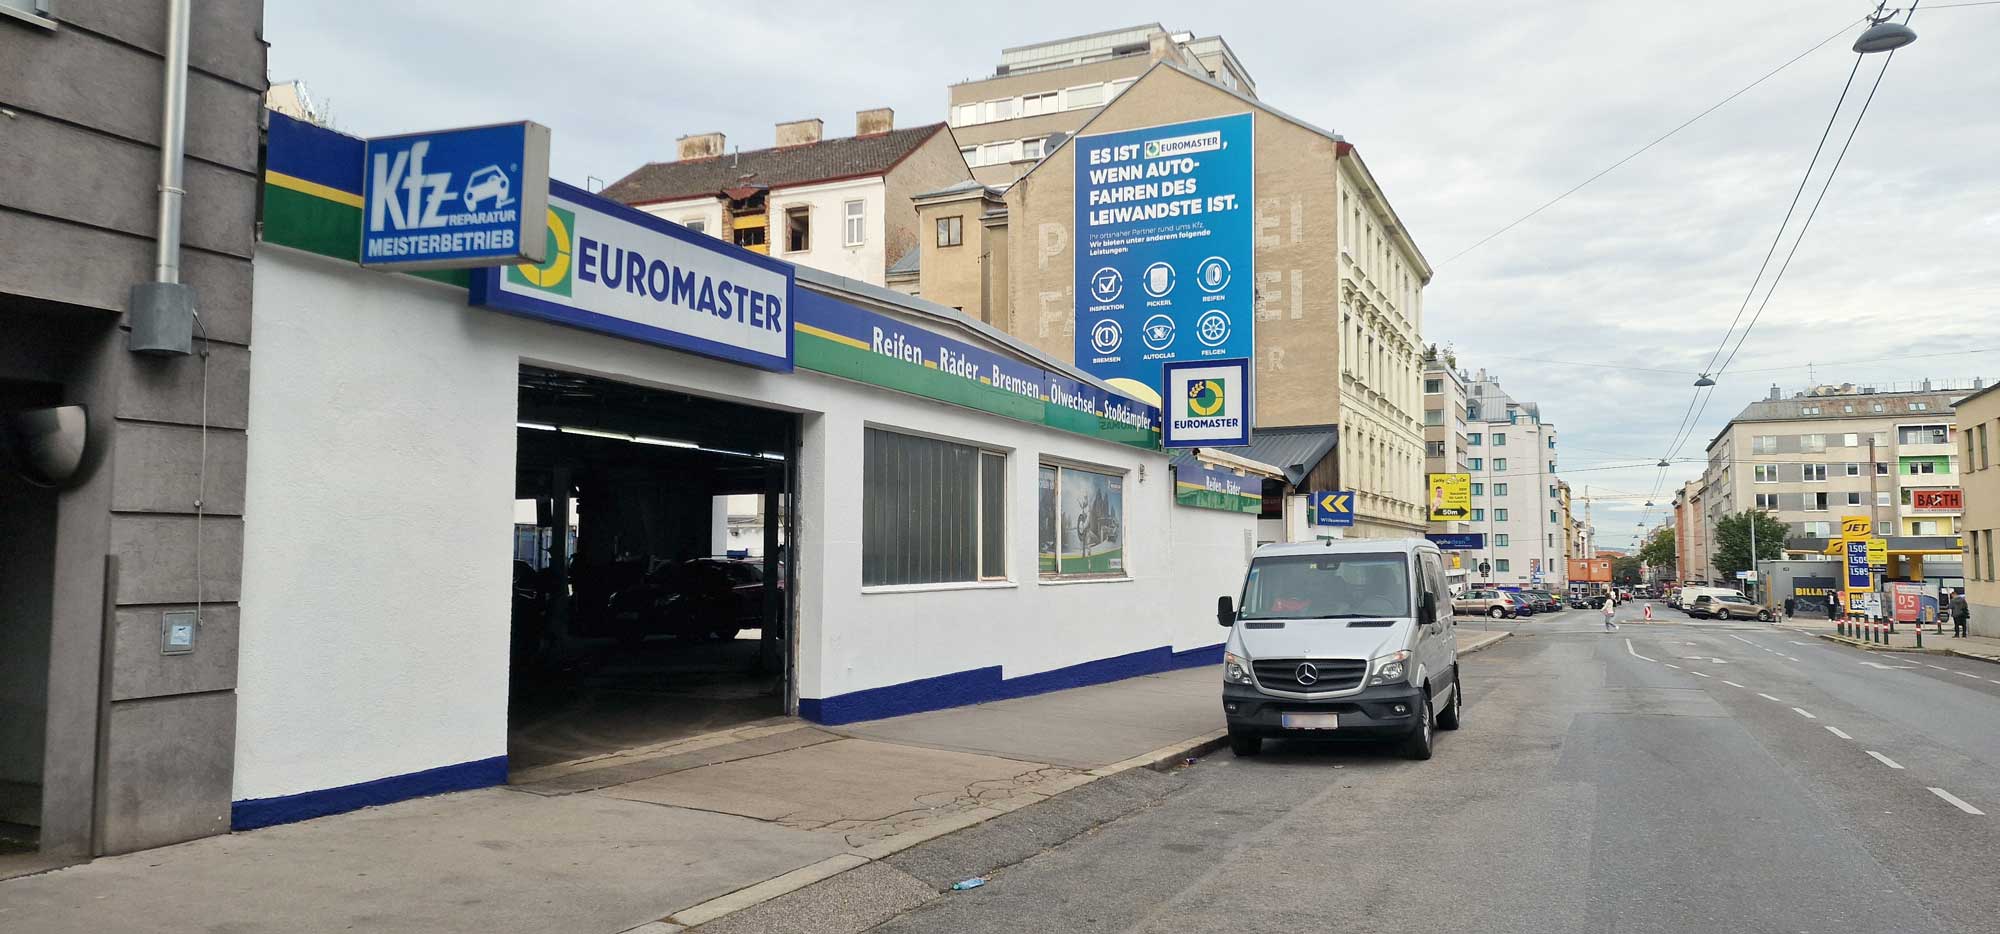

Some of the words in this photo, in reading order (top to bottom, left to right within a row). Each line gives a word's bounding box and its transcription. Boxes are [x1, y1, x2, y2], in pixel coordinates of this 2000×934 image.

[1090, 148, 1111, 165] ES
[1114, 144, 1140, 162] IST
[1090, 165, 1143, 185] WENN
[1146, 157, 1200, 178] AUTO-
[371, 140, 459, 232] Kfz
[1090, 183, 1158, 206] FAHREN
[1162, 178, 1197, 197] DES
[449, 210, 516, 226] REPARATUR
[1090, 198, 1203, 226] LEIWANDSTE
[1207, 194, 1239, 213] IST.
[1090, 233, 1099, 241] Ihr
[1099, 229, 1131, 240] ortsnaher
[1132, 227, 1156, 237] Partner
[1158, 225, 1174, 234] rund
[1176, 223, 1191, 232] ums
[1090, 240, 1102, 249] Wir
[1103, 238, 1125, 247] bieten
[1126, 236, 1145, 245] unter
[1146, 232, 1178, 243] anderem
[1179, 229, 1212, 240] folgende
[368, 229, 515, 257] MEISTERBETRIEB
[1090, 246, 1129, 256] Leistungen:
[578, 236, 783, 333] EUROMASTER
[1146, 299, 1172, 308] PICKERL
[1202, 294, 1226, 303] REIFEN
[1089, 303, 1125, 312] INSPEKTION
[1092, 356, 1121, 365] BREMSEN
[873, 326, 922, 365] Reifen
[939, 347, 979, 381] Räder
[992, 365, 1039, 400] Bremsen
[1051, 379, 1096, 416] Ölwechsel
[1104, 399, 1151, 432] Stoßdämpfer
[1174, 418, 1239, 430] EUROMASTER
[1918, 494, 1959, 506] BARTH
[1845, 524, 1868, 532] JET
[1795, 587, 1823, 596] BILLA
